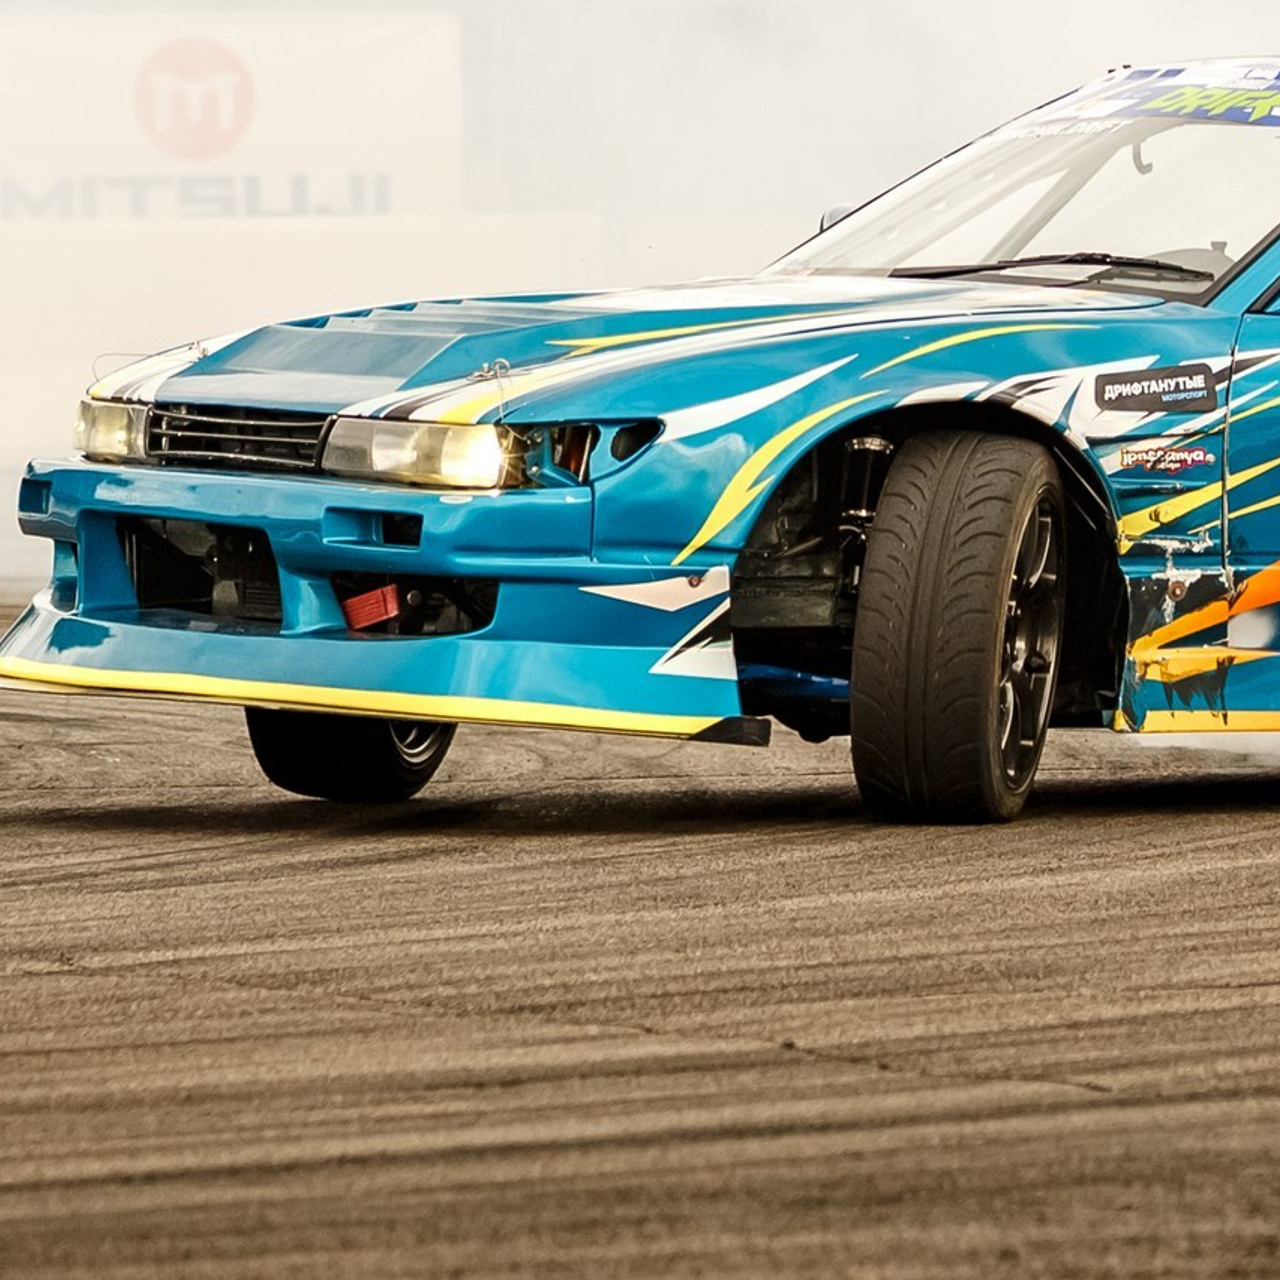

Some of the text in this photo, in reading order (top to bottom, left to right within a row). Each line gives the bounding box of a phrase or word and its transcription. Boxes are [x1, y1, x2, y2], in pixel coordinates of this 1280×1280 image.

[0, 173, 391, 220] MITSUJI
[1104, 375, 1206, 401] ДРИФТАНУТЫЕ
[1161, 389, 1208, 402] МОТОРСПОРТ
